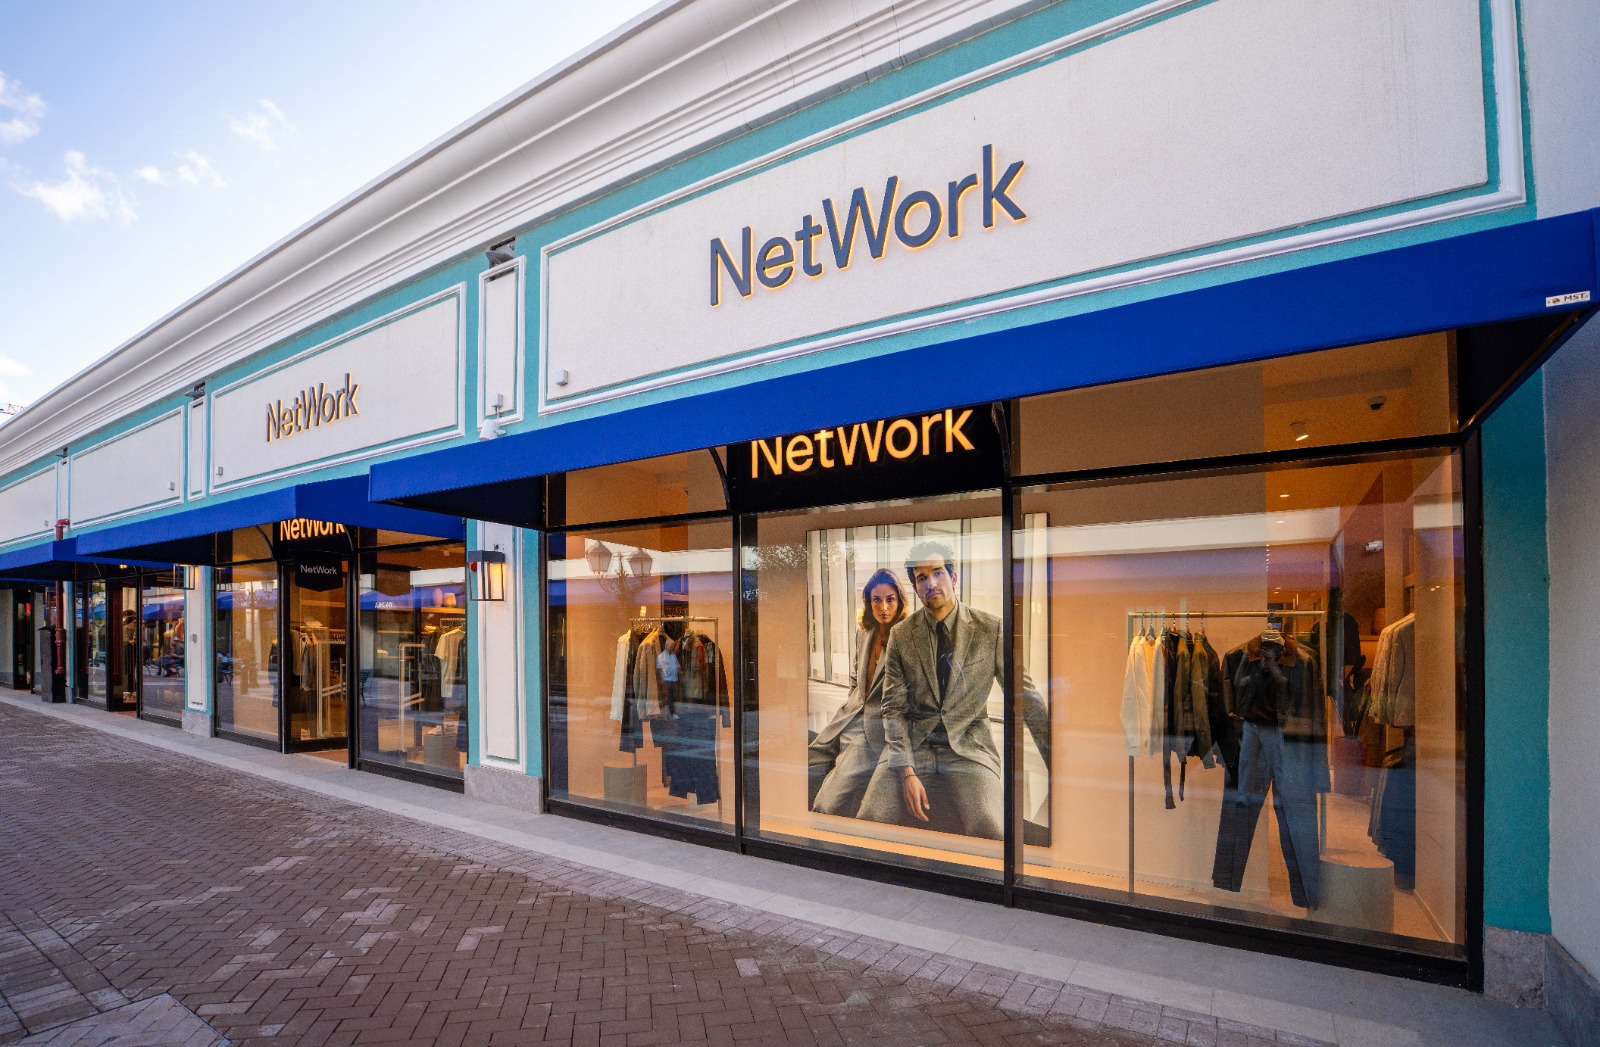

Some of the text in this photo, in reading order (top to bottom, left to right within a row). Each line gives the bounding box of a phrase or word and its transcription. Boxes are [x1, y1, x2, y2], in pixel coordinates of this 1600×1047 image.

[710, 143, 1027, 307] NetWork
[1564, 292, 1586, 302] MST
[266, 372, 359, 443] NetWork
[751, 409, 976, 479] NetWork
[300, 564, 338, 575] NetWork
